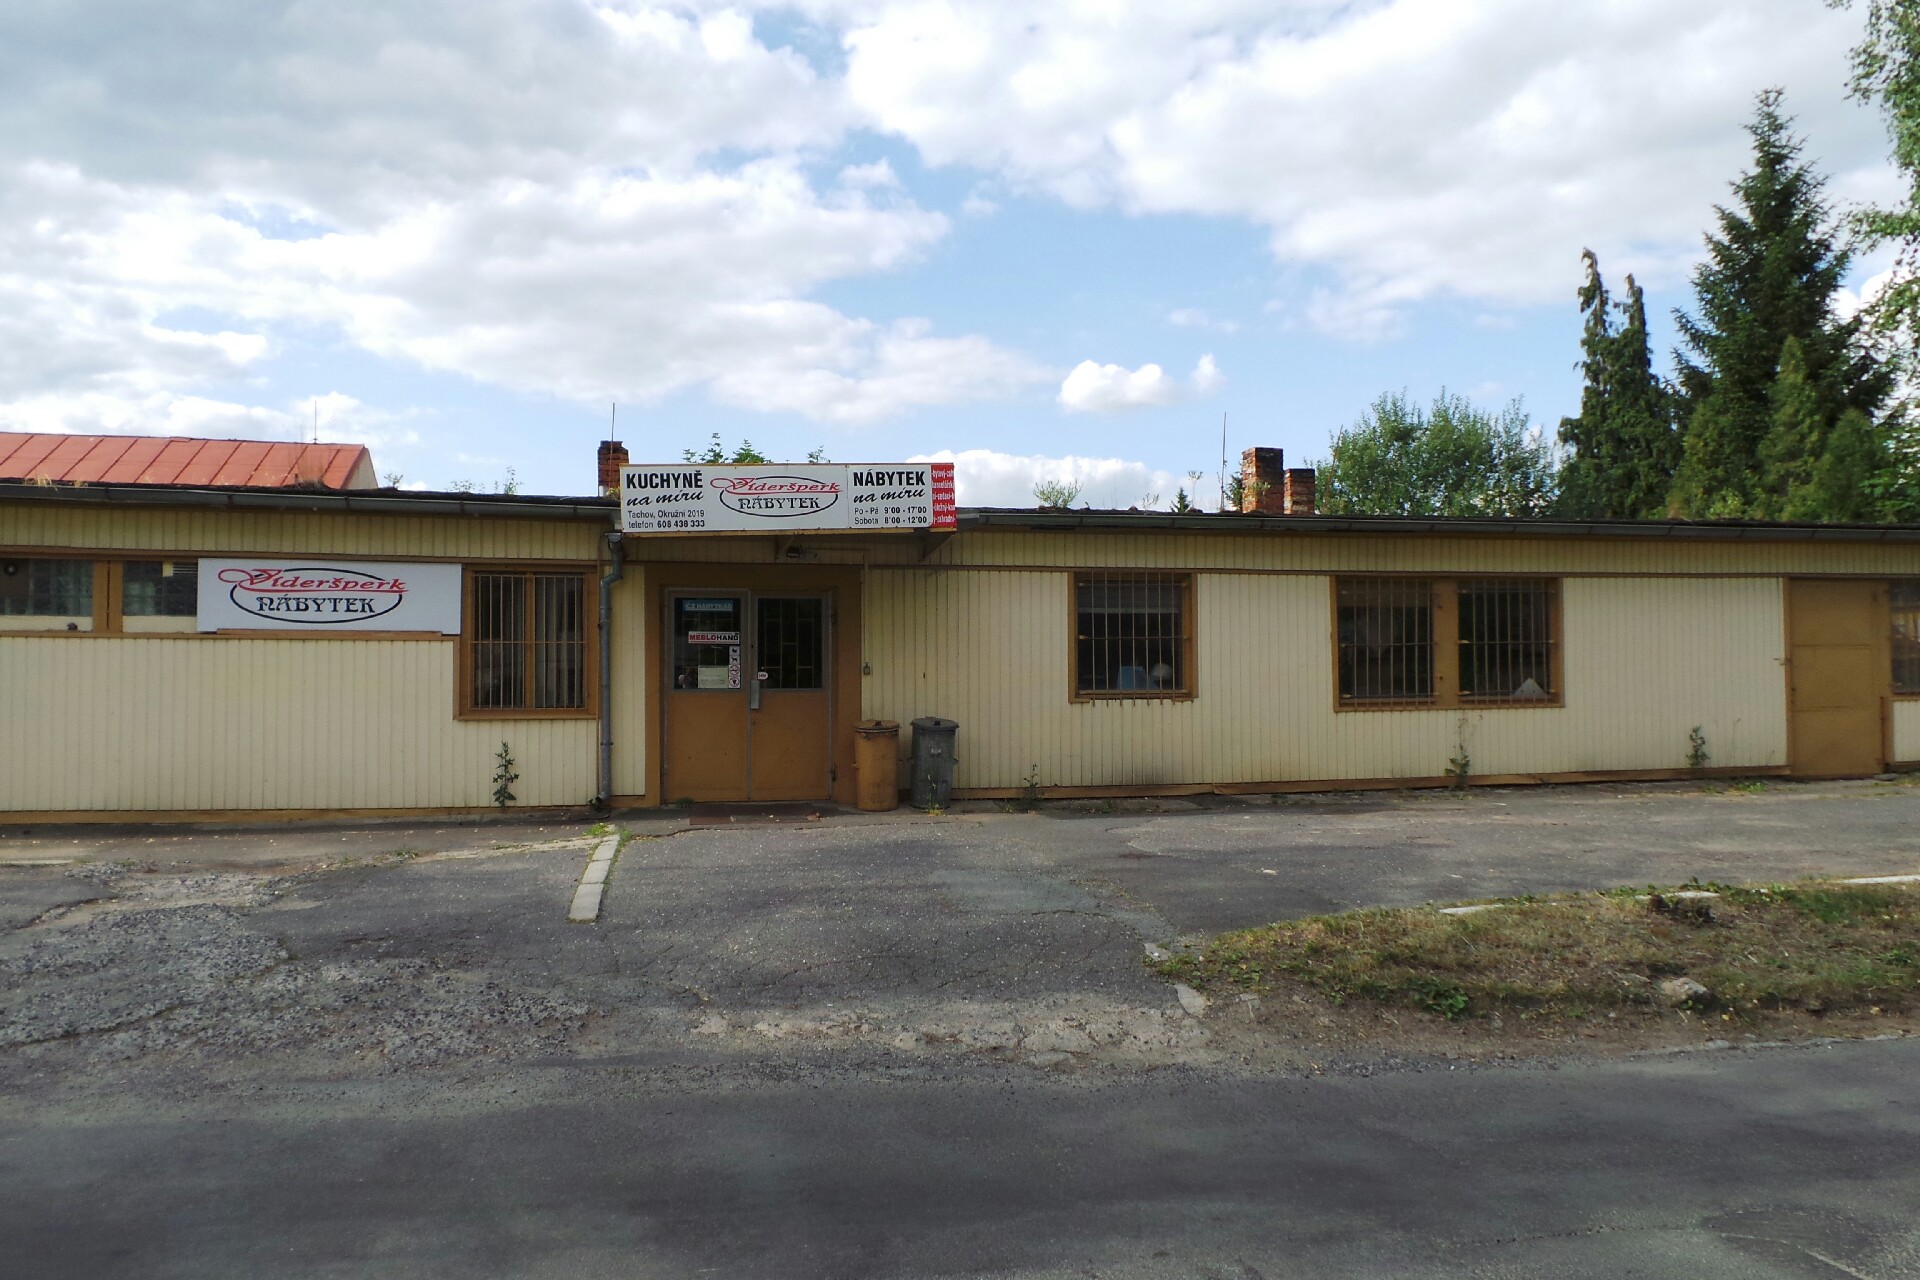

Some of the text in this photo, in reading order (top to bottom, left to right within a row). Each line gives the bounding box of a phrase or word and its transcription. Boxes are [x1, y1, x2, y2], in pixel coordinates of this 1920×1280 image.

[626, 470, 703, 489] KUCHYNĚ
[853, 469, 925, 486] NÁBYTEK
[627, 490, 704, 506] na míru
[738, 496, 820, 509] NÁBYTEK
[854, 487, 925, 503] na míru
[628, 510, 655, 519] Tachov,
[688, 510, 705, 518] 2019
[854, 517, 879, 525] Sobota
[629, 520, 705, 528] telefon 608 438 333
[255, 594, 376, 613] NÁBYTEK
